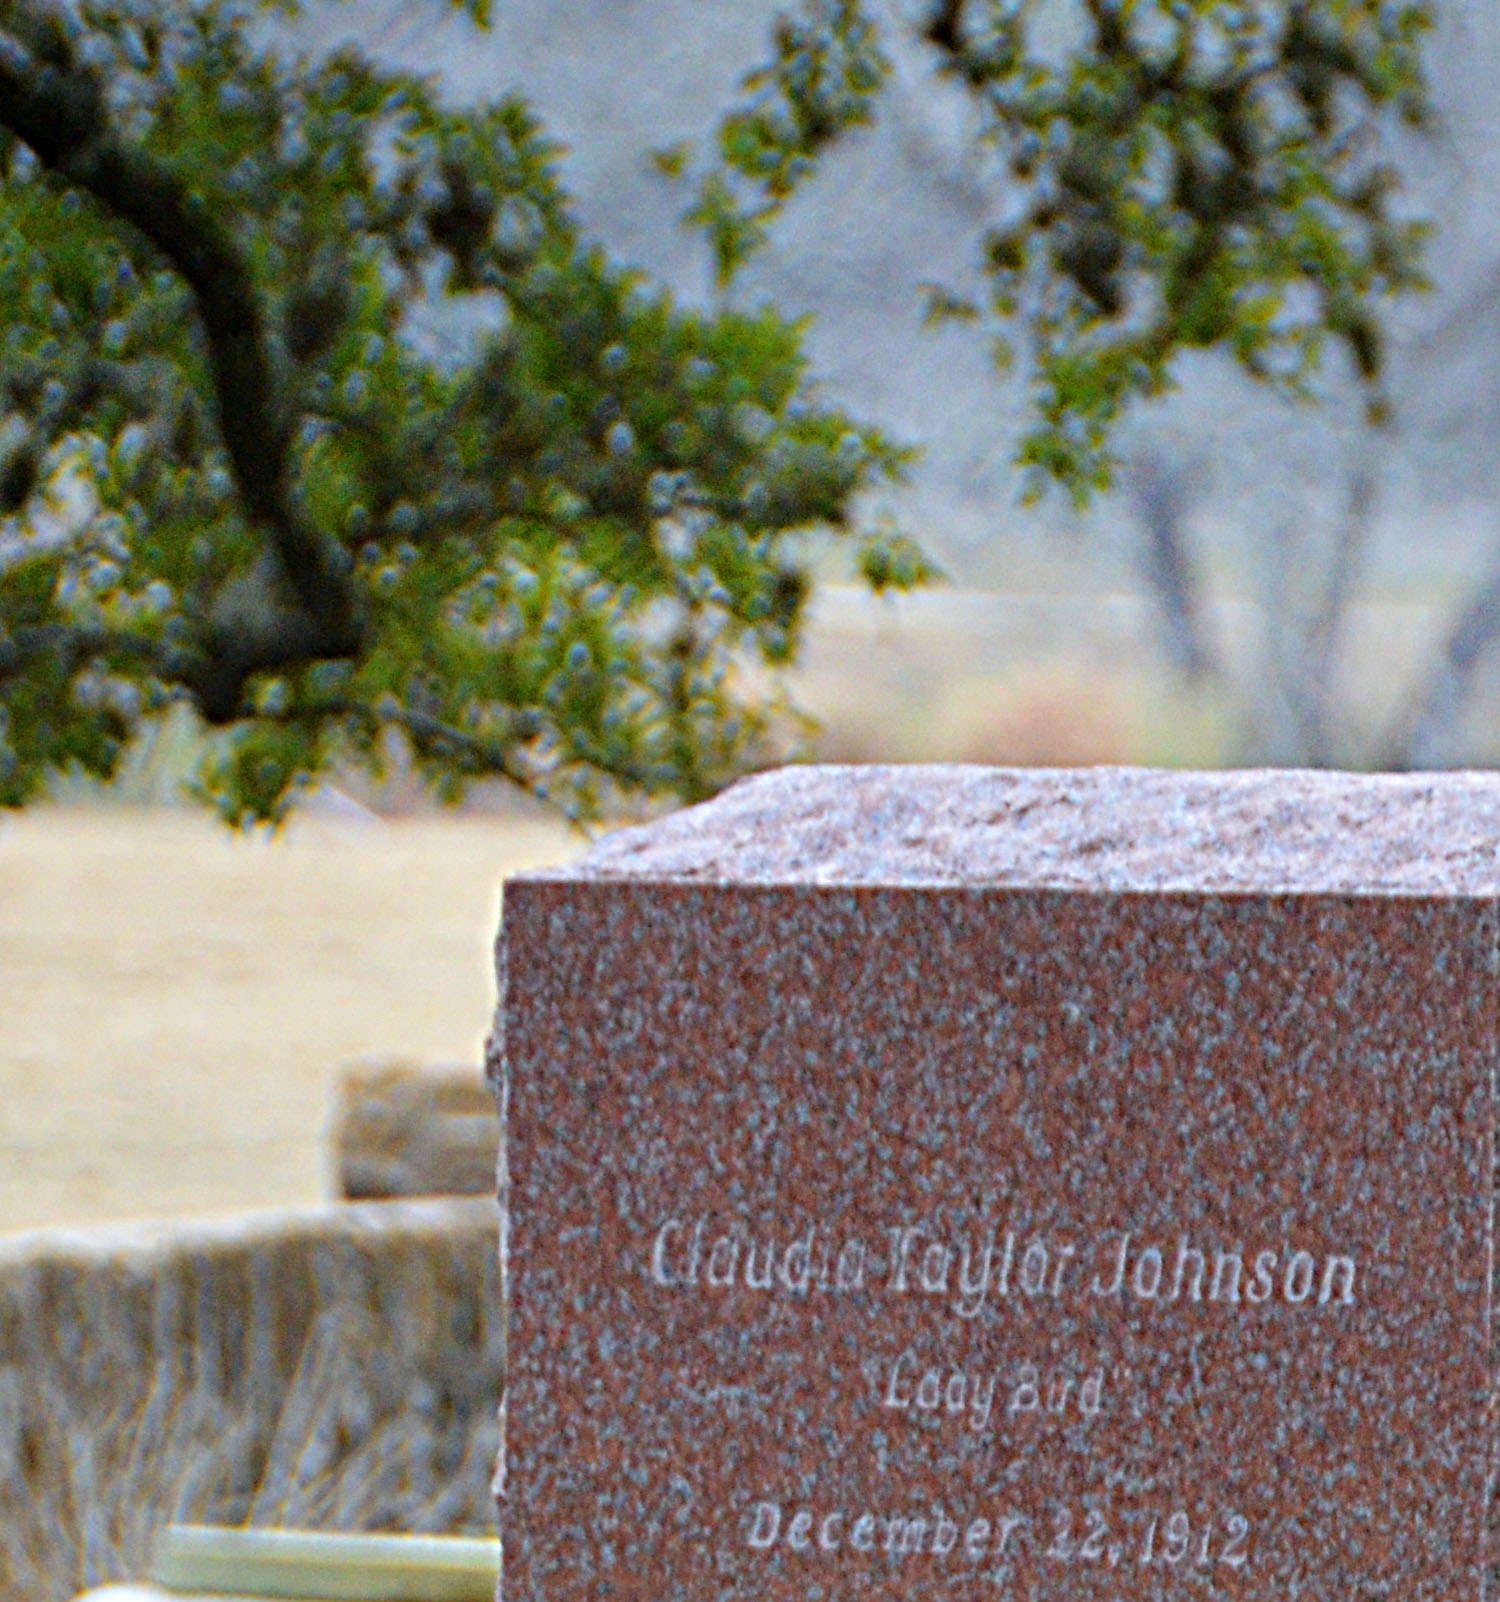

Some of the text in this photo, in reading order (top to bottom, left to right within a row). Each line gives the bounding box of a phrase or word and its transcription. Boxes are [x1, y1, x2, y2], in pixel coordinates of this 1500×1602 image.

[651, 1216, 1357, 1318] Claudia Taylor Johnson
[746, 1501, 1018, 1556] December
[1138, 1512, 1250, 1569] 1912
